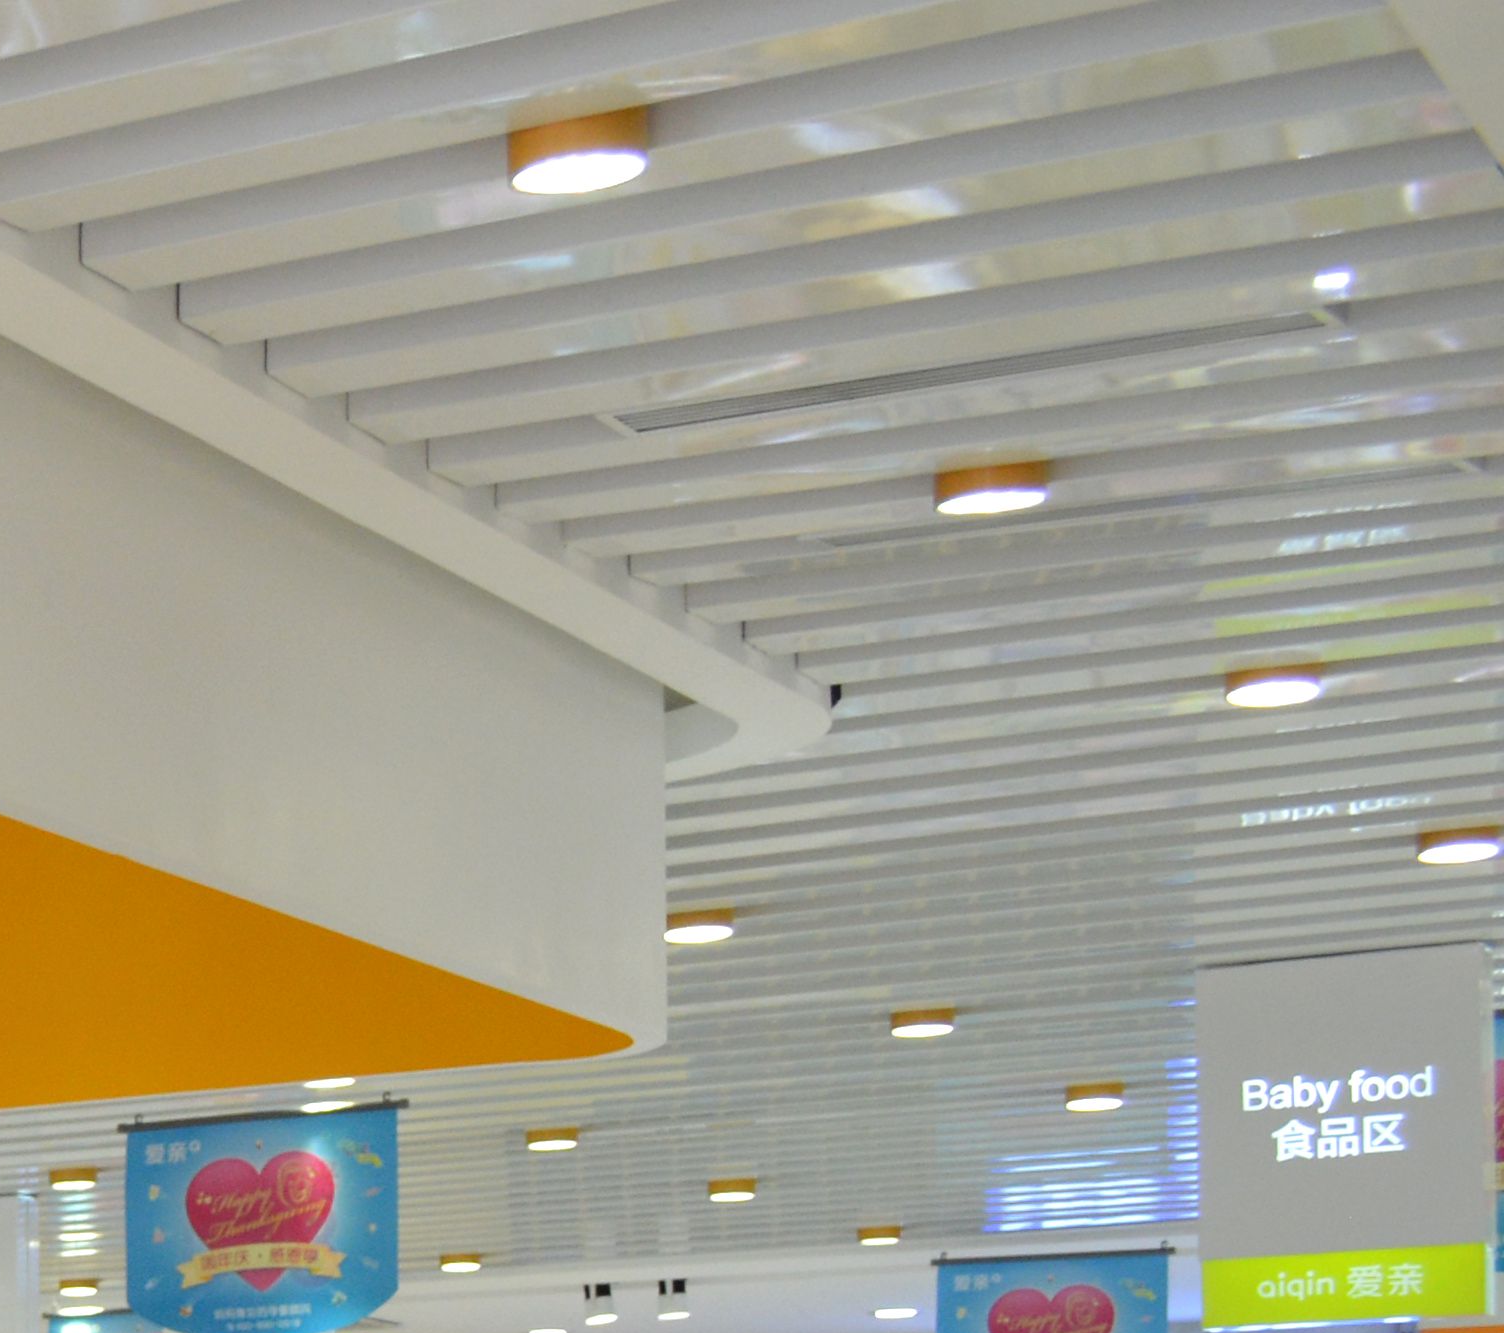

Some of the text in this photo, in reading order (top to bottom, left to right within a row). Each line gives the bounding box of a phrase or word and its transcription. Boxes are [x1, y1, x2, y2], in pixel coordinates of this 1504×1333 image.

[1242, 1064, 1435, 1116] Baby food
[1271, 1113, 1407, 1163] 食品区
[1257, 1261, 1424, 1303] aiqin 爱亲
